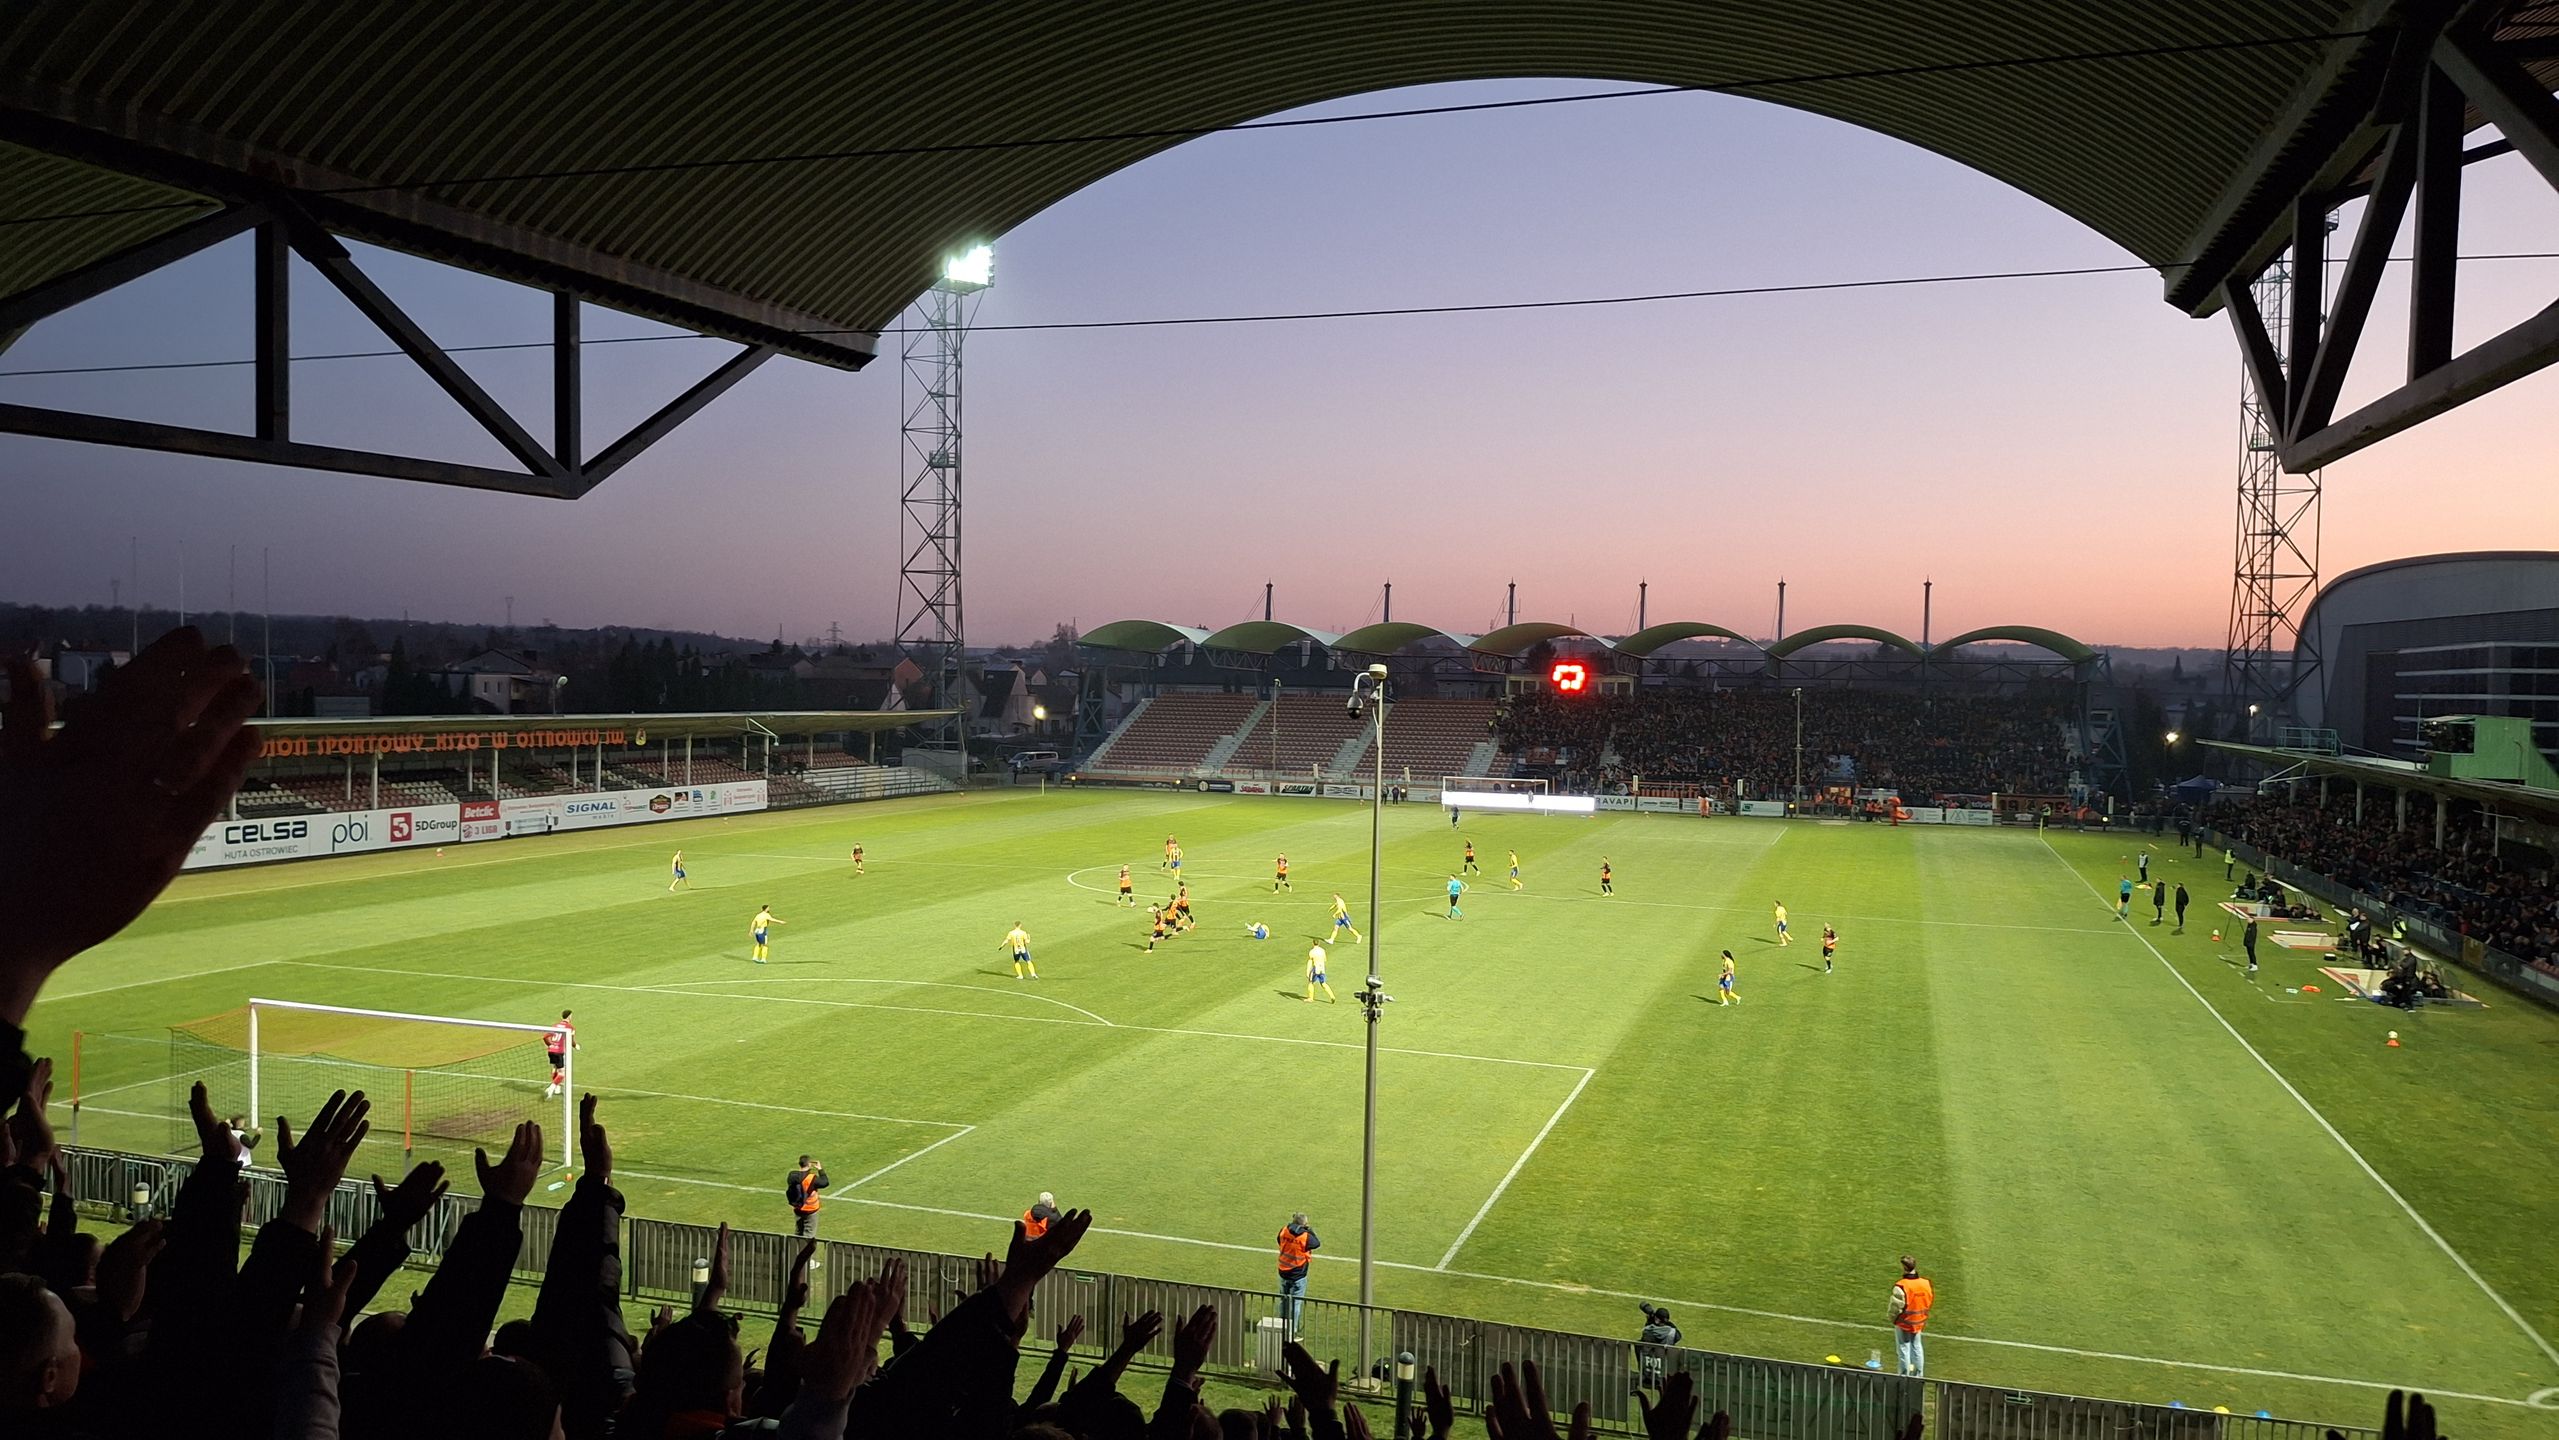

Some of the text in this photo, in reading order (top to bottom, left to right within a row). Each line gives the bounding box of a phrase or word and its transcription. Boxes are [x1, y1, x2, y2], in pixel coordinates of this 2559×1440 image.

[464, 804, 495, 819] Betclic
[566, 802, 616, 814] SIGNAL
[332, 814, 368, 852] pbi
[392, 816, 409, 838] 5
[415, 819, 458, 832] 5DGroup
[224, 844, 299, 860] HUTA OSTROWIEC
